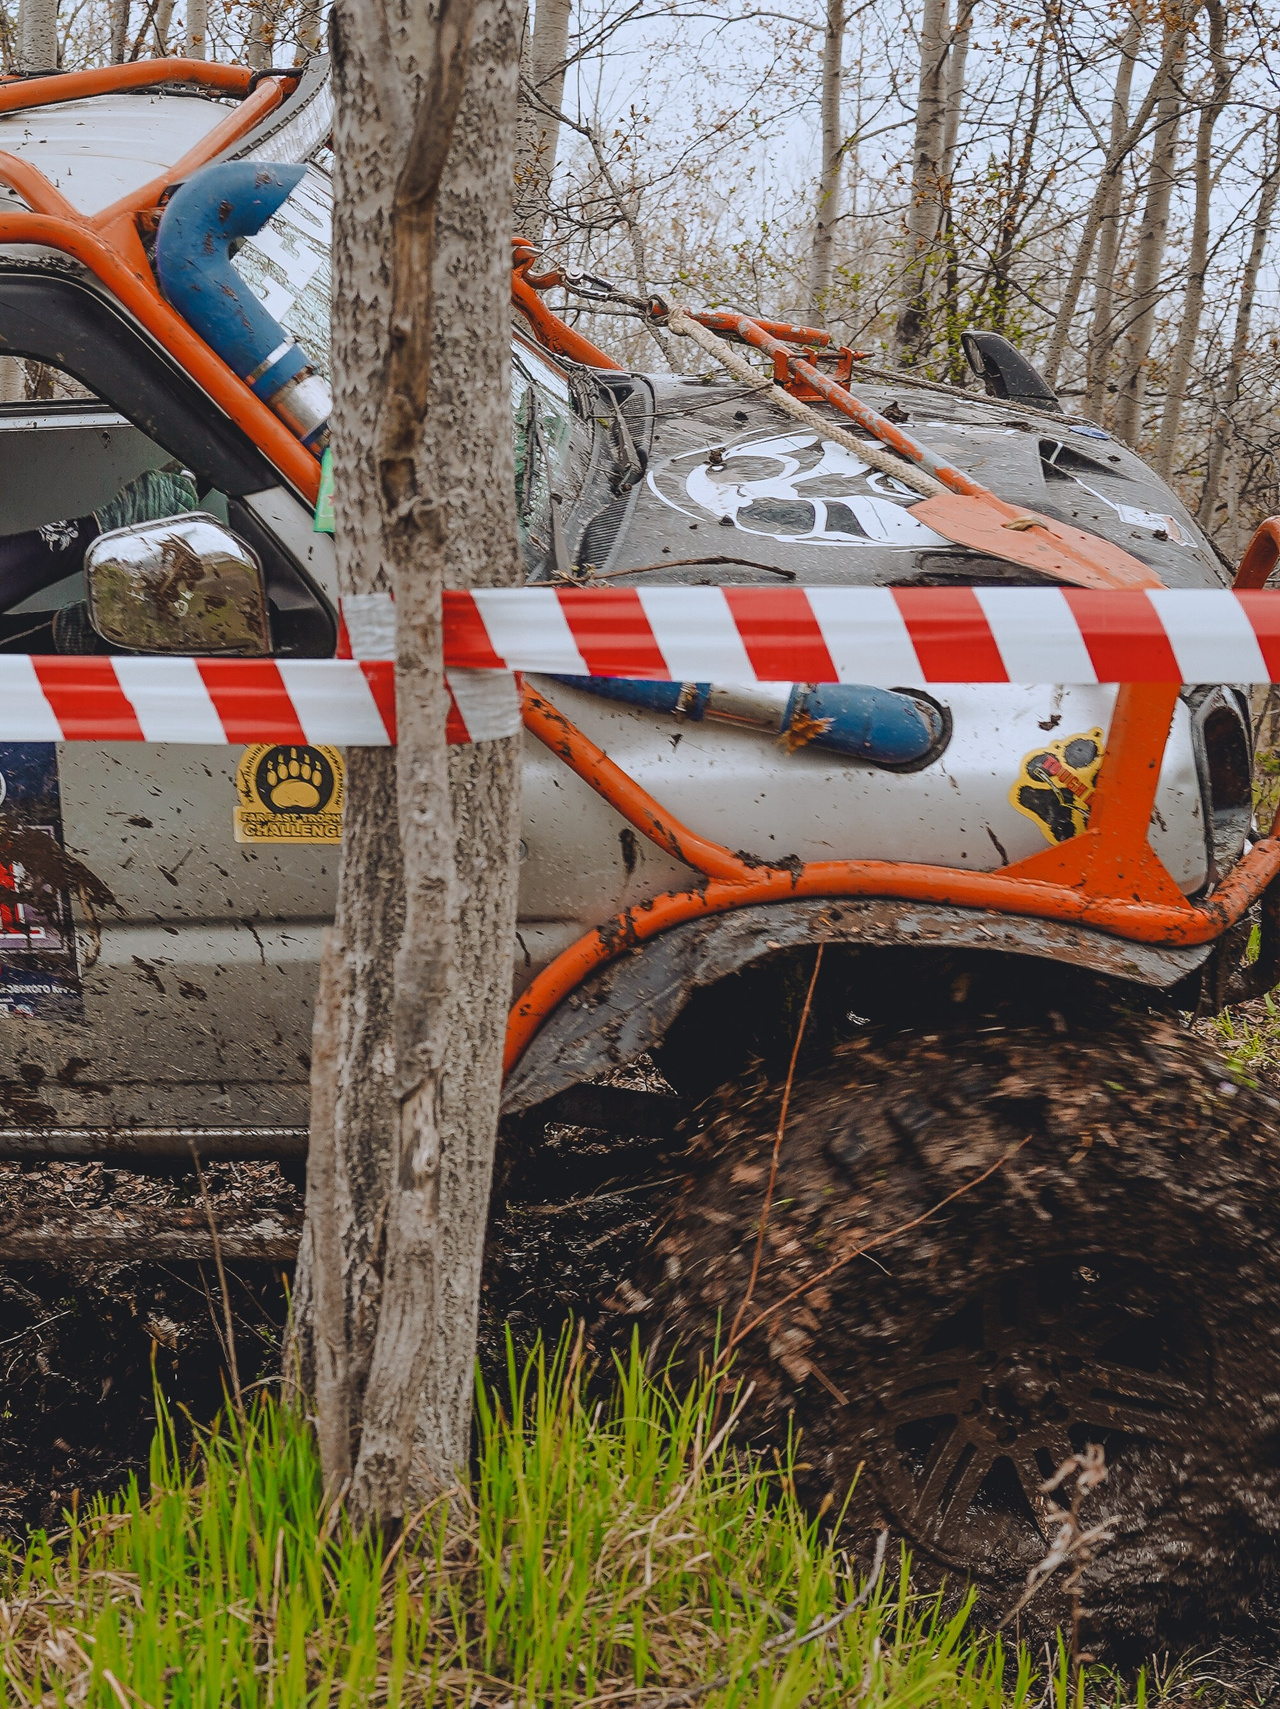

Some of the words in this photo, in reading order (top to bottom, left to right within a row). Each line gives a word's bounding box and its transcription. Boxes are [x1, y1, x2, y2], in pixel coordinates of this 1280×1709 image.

[1042, 754, 1089, 798] TOUGH
[241, 812, 268, 823] FAR
[268, 812, 300, 823] EAST
[300, 812, 342, 823] TROPH
